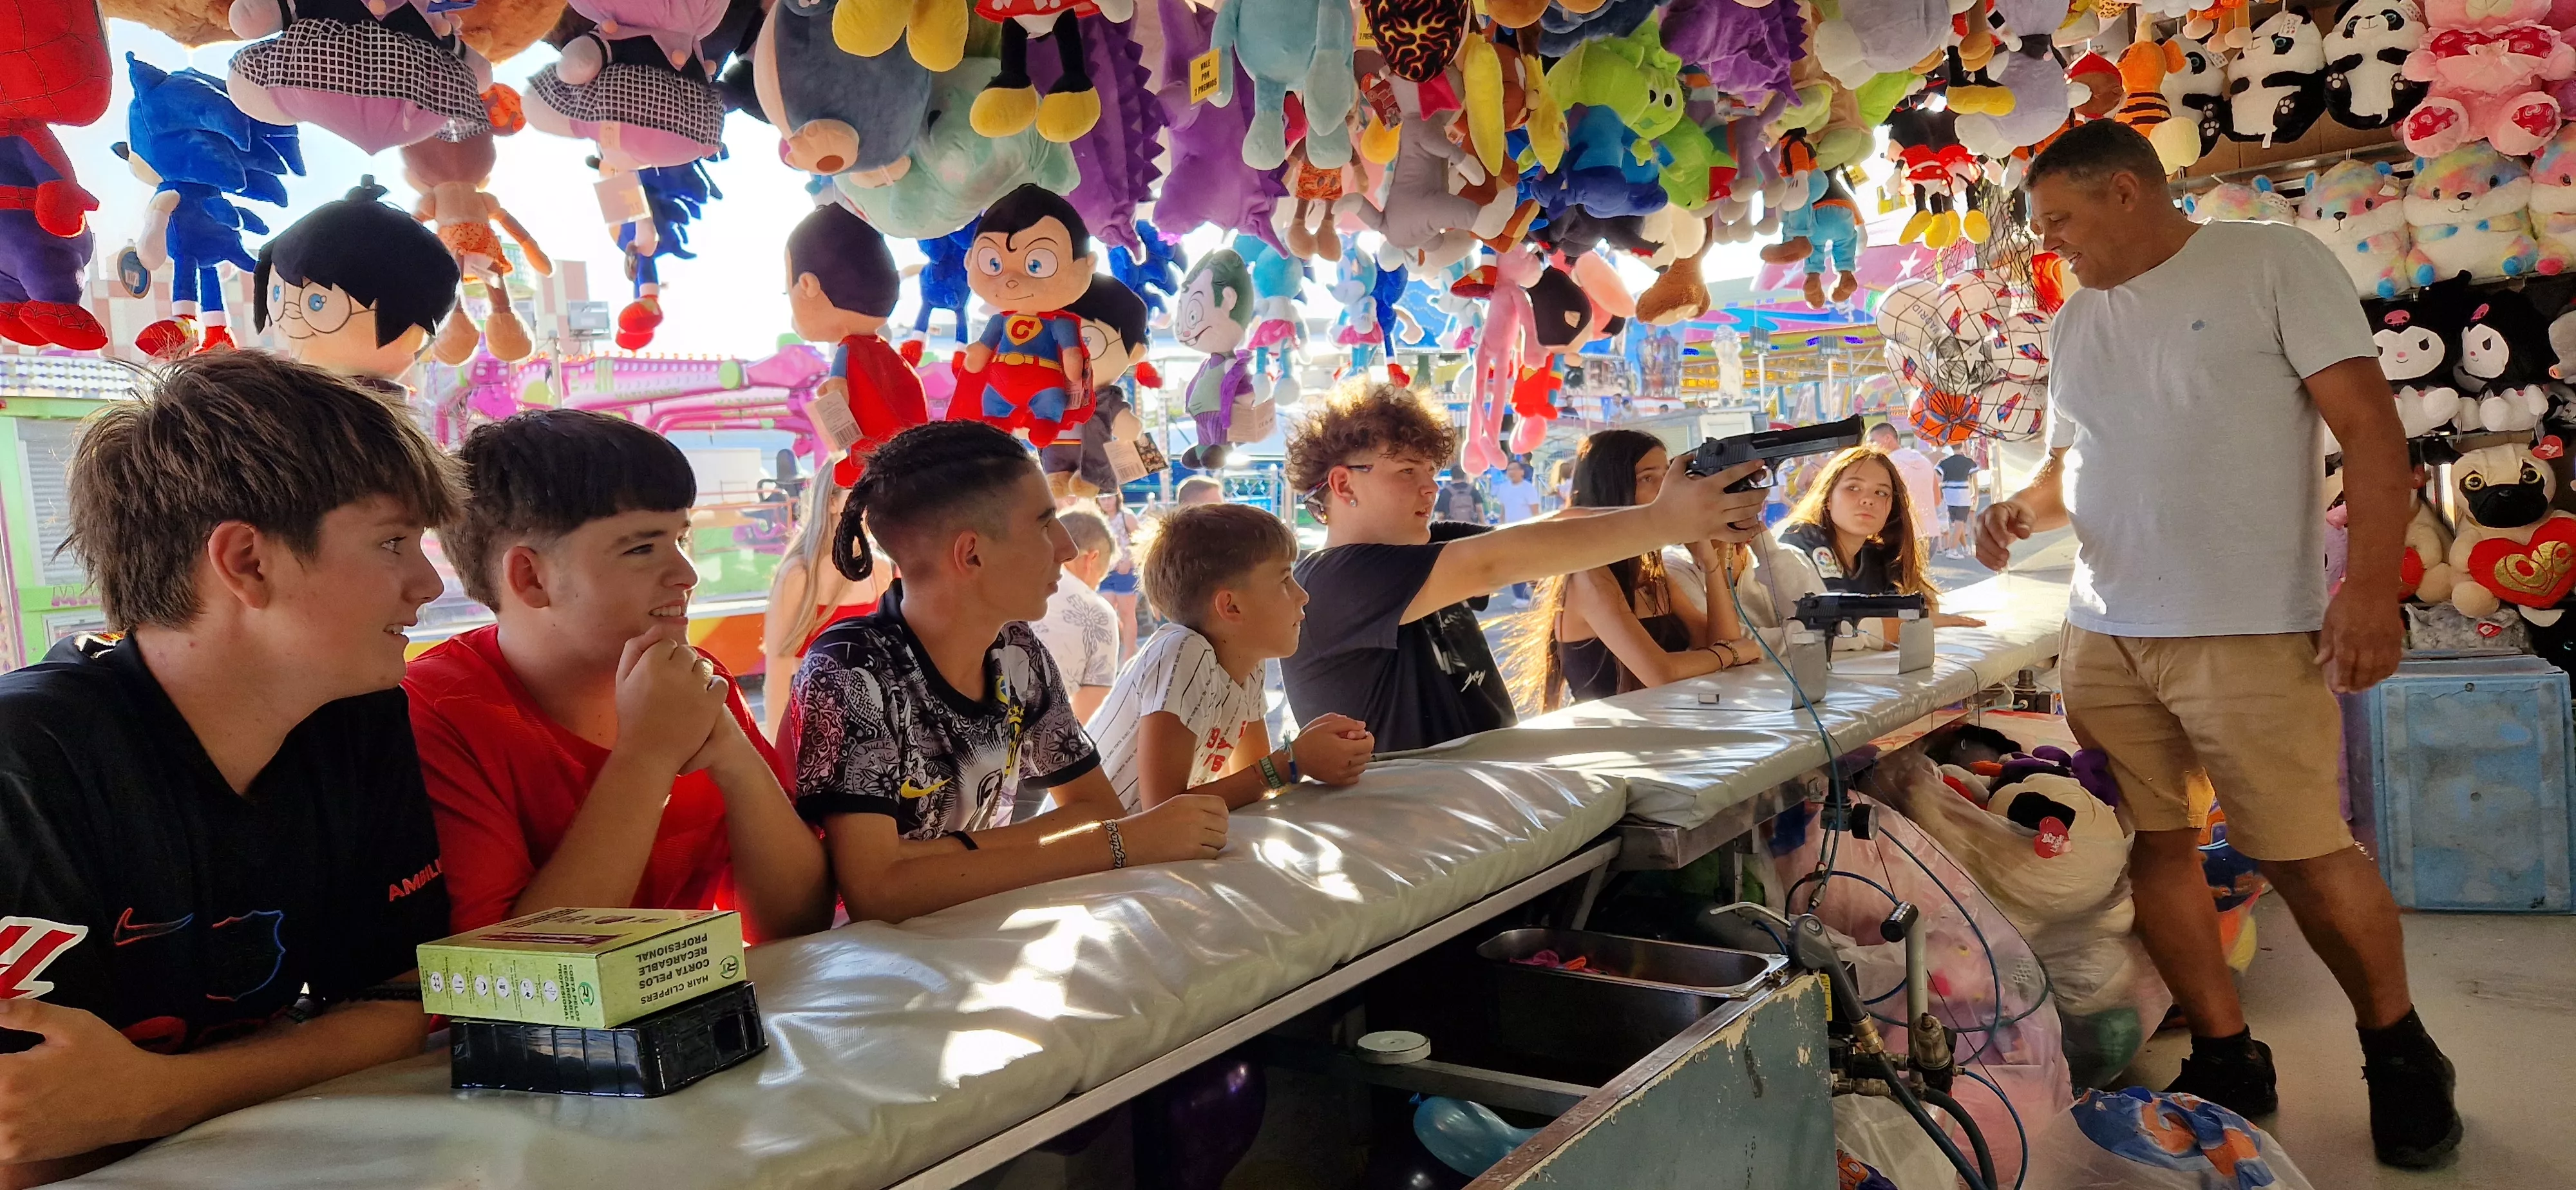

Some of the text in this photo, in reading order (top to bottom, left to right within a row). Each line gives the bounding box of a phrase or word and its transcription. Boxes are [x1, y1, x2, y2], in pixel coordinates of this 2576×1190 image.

[1200, 59, 1211, 71] VALE
[1195, 78, 1217, 96] 2 PREMIOS
[635, 933, 708, 963] PROFESIONAL
[638, 946, 708, 976] RECARGABLE
[639, 958, 710, 989] CORTA PELOS
[558, 963, 569, 1021] PROFESIONAL
[563, 965, 574, 1021] RECARGABLE
[640, 974, 708, 1005] HAIR CLIPPERS
[572, 995, 580, 1022] PELOS
